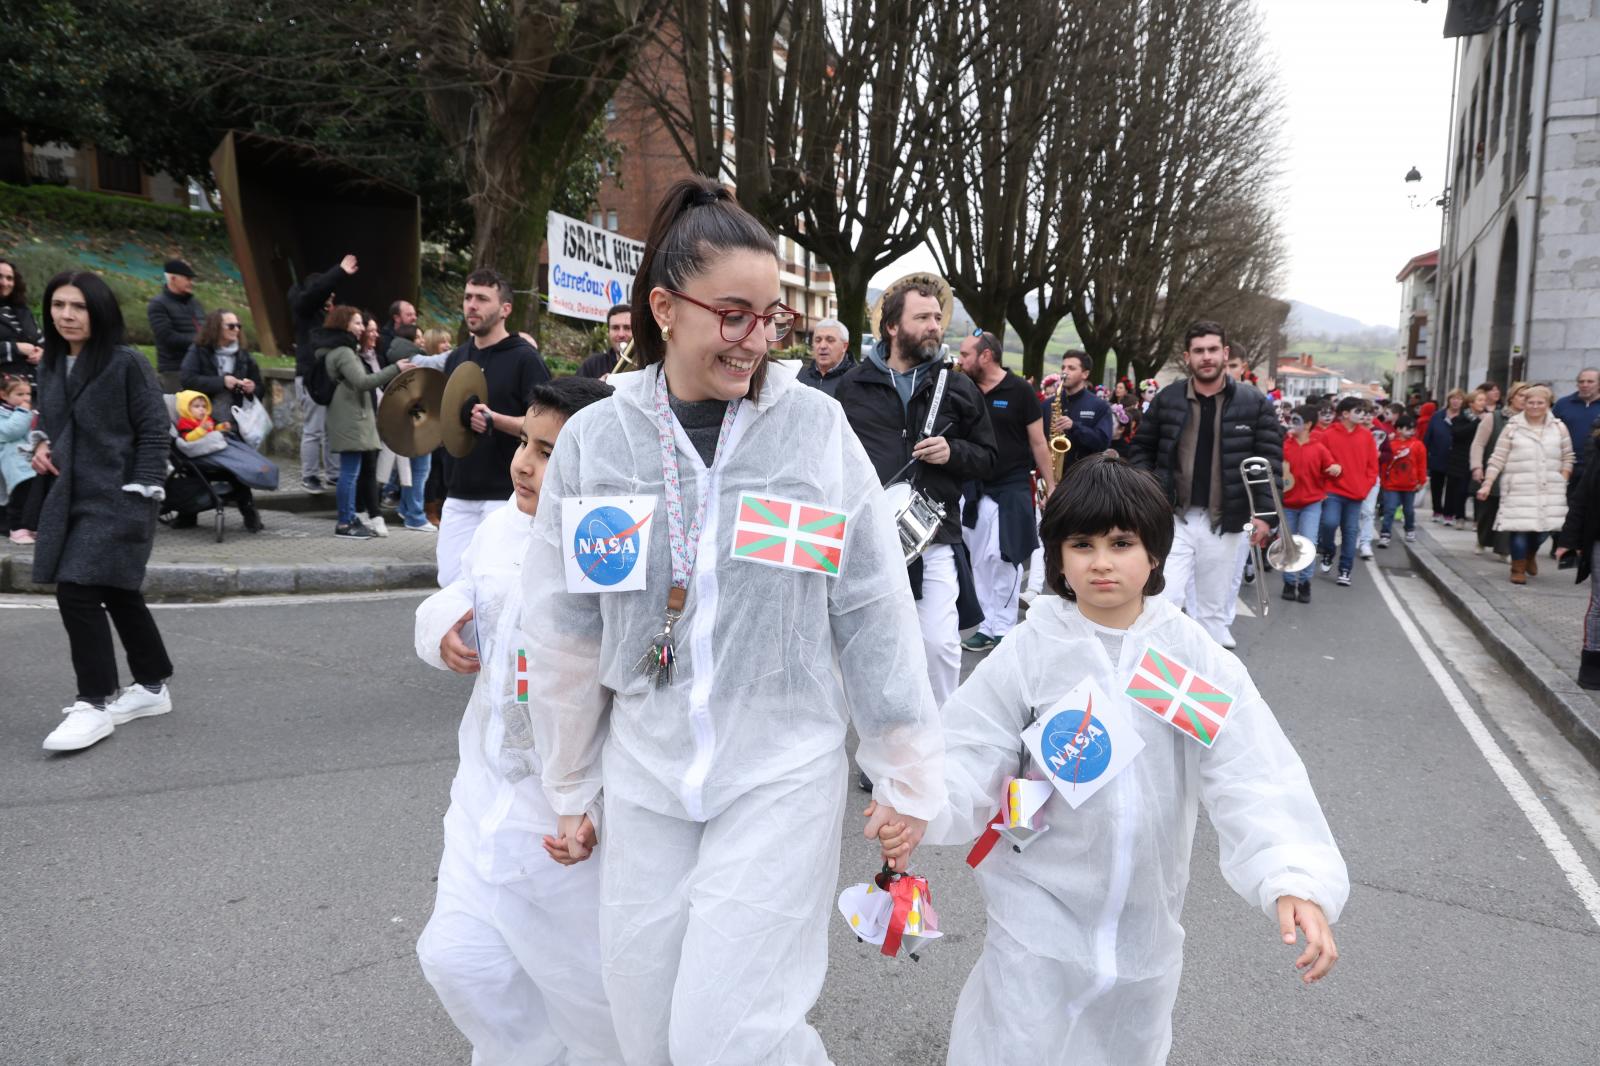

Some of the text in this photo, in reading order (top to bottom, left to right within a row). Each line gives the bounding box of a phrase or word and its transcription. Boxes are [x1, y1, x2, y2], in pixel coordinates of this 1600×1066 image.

[563, 222, 612, 270] ISRAEL
[553, 264, 604, 297] Carrefour
[578, 537, 636, 554] NASA
[1049, 724, 1104, 770] NASA
